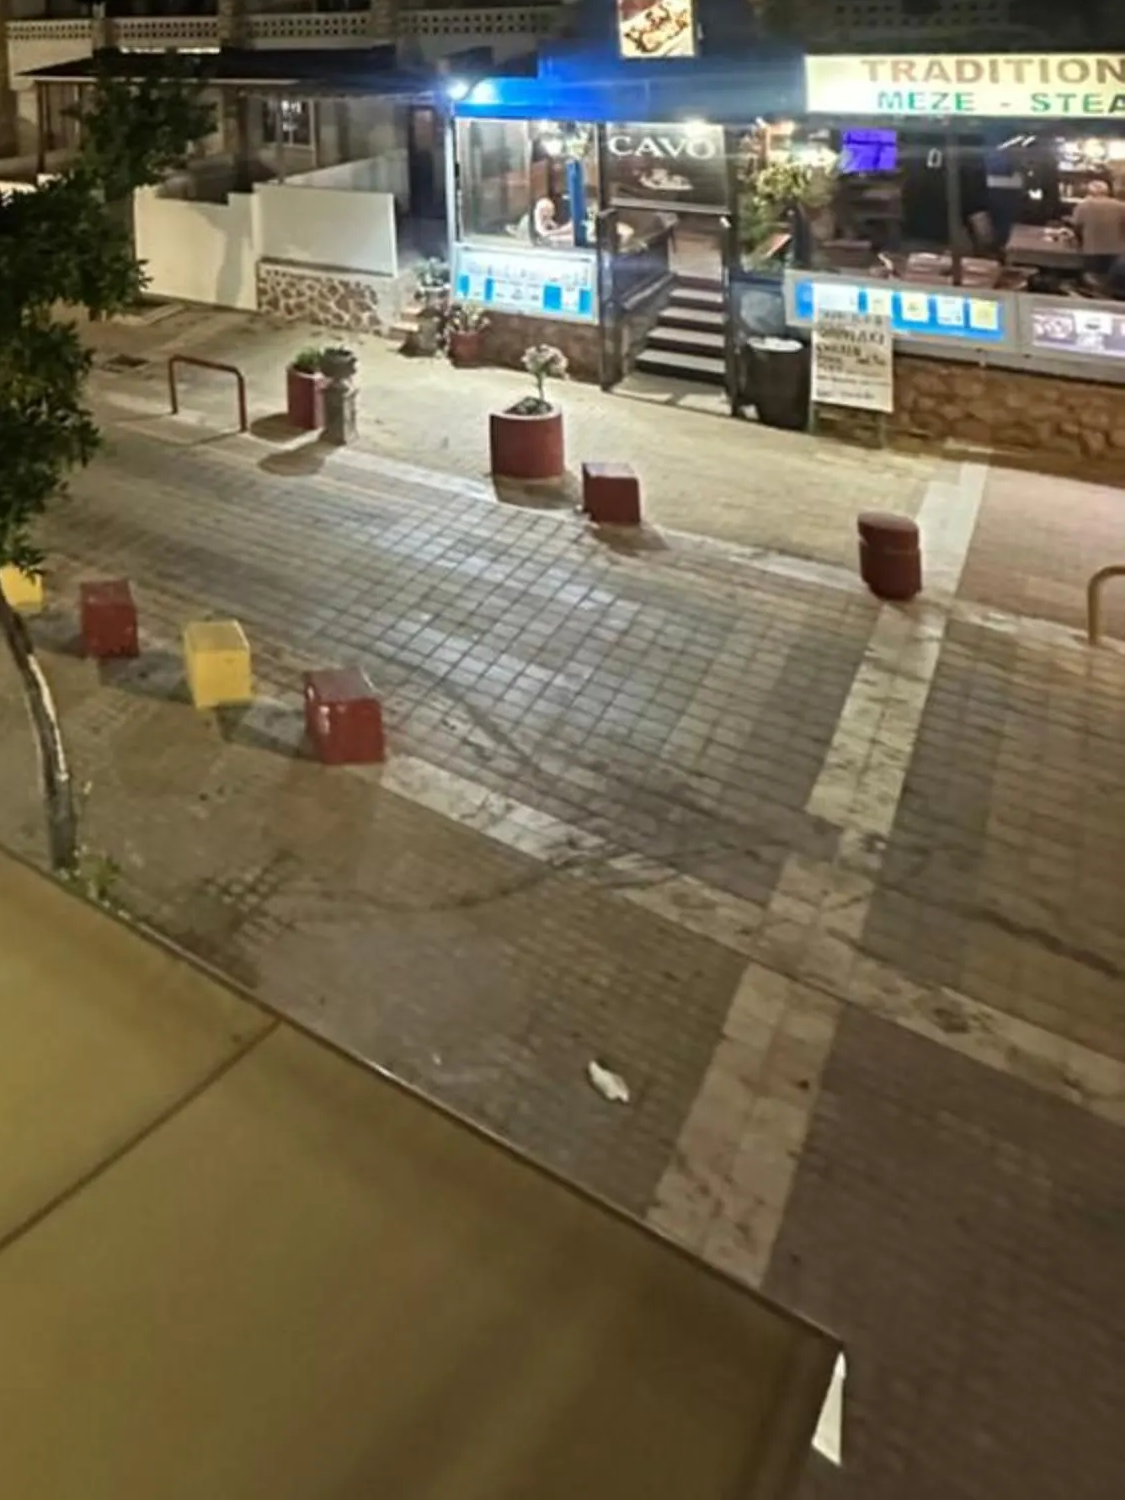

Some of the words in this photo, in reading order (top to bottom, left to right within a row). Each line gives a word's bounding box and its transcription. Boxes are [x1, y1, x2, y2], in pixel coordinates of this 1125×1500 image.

[860, 57, 1125, 84] TRADITION
[877, 91, 977, 111] MEZE
[608, 135, 716, 160] CAVO
